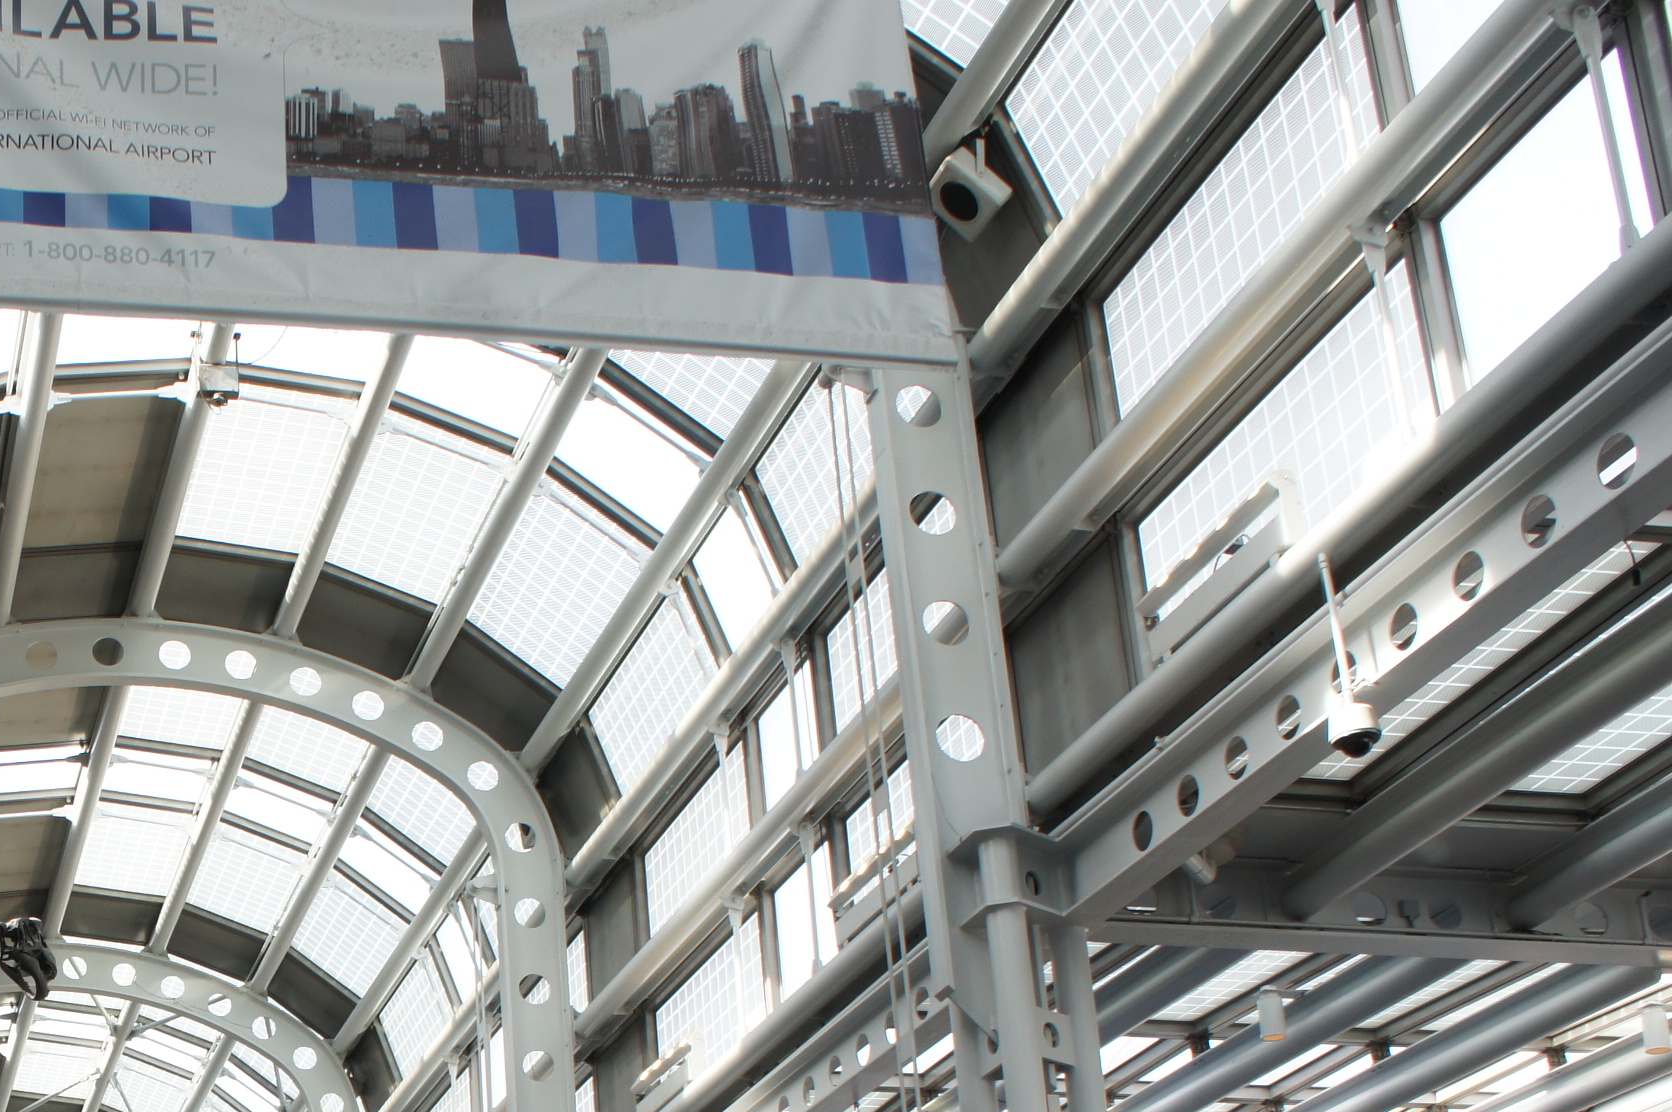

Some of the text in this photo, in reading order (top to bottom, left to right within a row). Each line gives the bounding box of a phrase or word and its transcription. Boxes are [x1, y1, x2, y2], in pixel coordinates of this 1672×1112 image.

[90, 61, 219, 96] WIDE!
[69, 111, 107, 129] WI-FI
[111, 117, 190, 137] NETWORK
[194, 124, 216, 139] OF
[124, 142, 218, 166] AIRPORT
[23, 240, 217, 270] 1-800-880-4117
